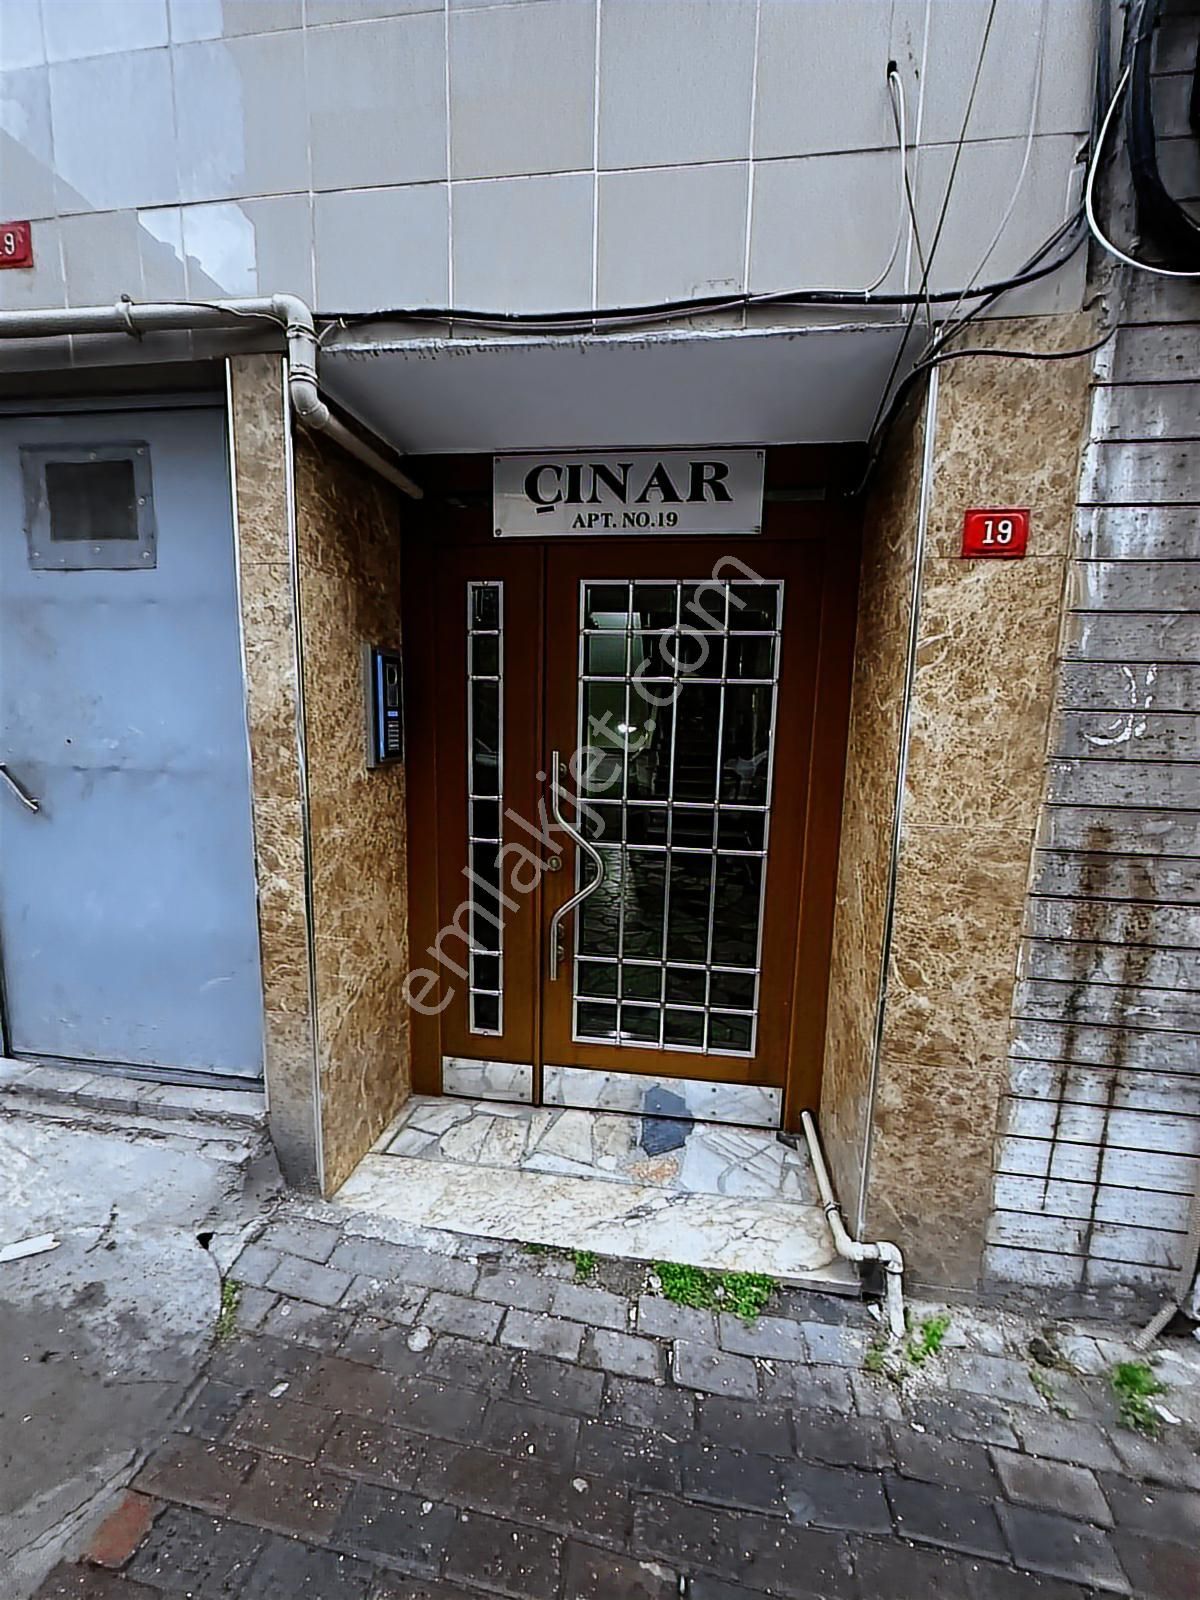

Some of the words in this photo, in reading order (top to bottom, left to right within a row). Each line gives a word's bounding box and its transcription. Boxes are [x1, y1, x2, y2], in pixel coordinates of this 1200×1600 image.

[0, 232, 15, 255] 9
[524, 461, 734, 514] ÇINAR
[572, 513, 617, 529] APT.
[622, 511, 679, 528] NO.19
[982, 520, 1013, 544] 19
